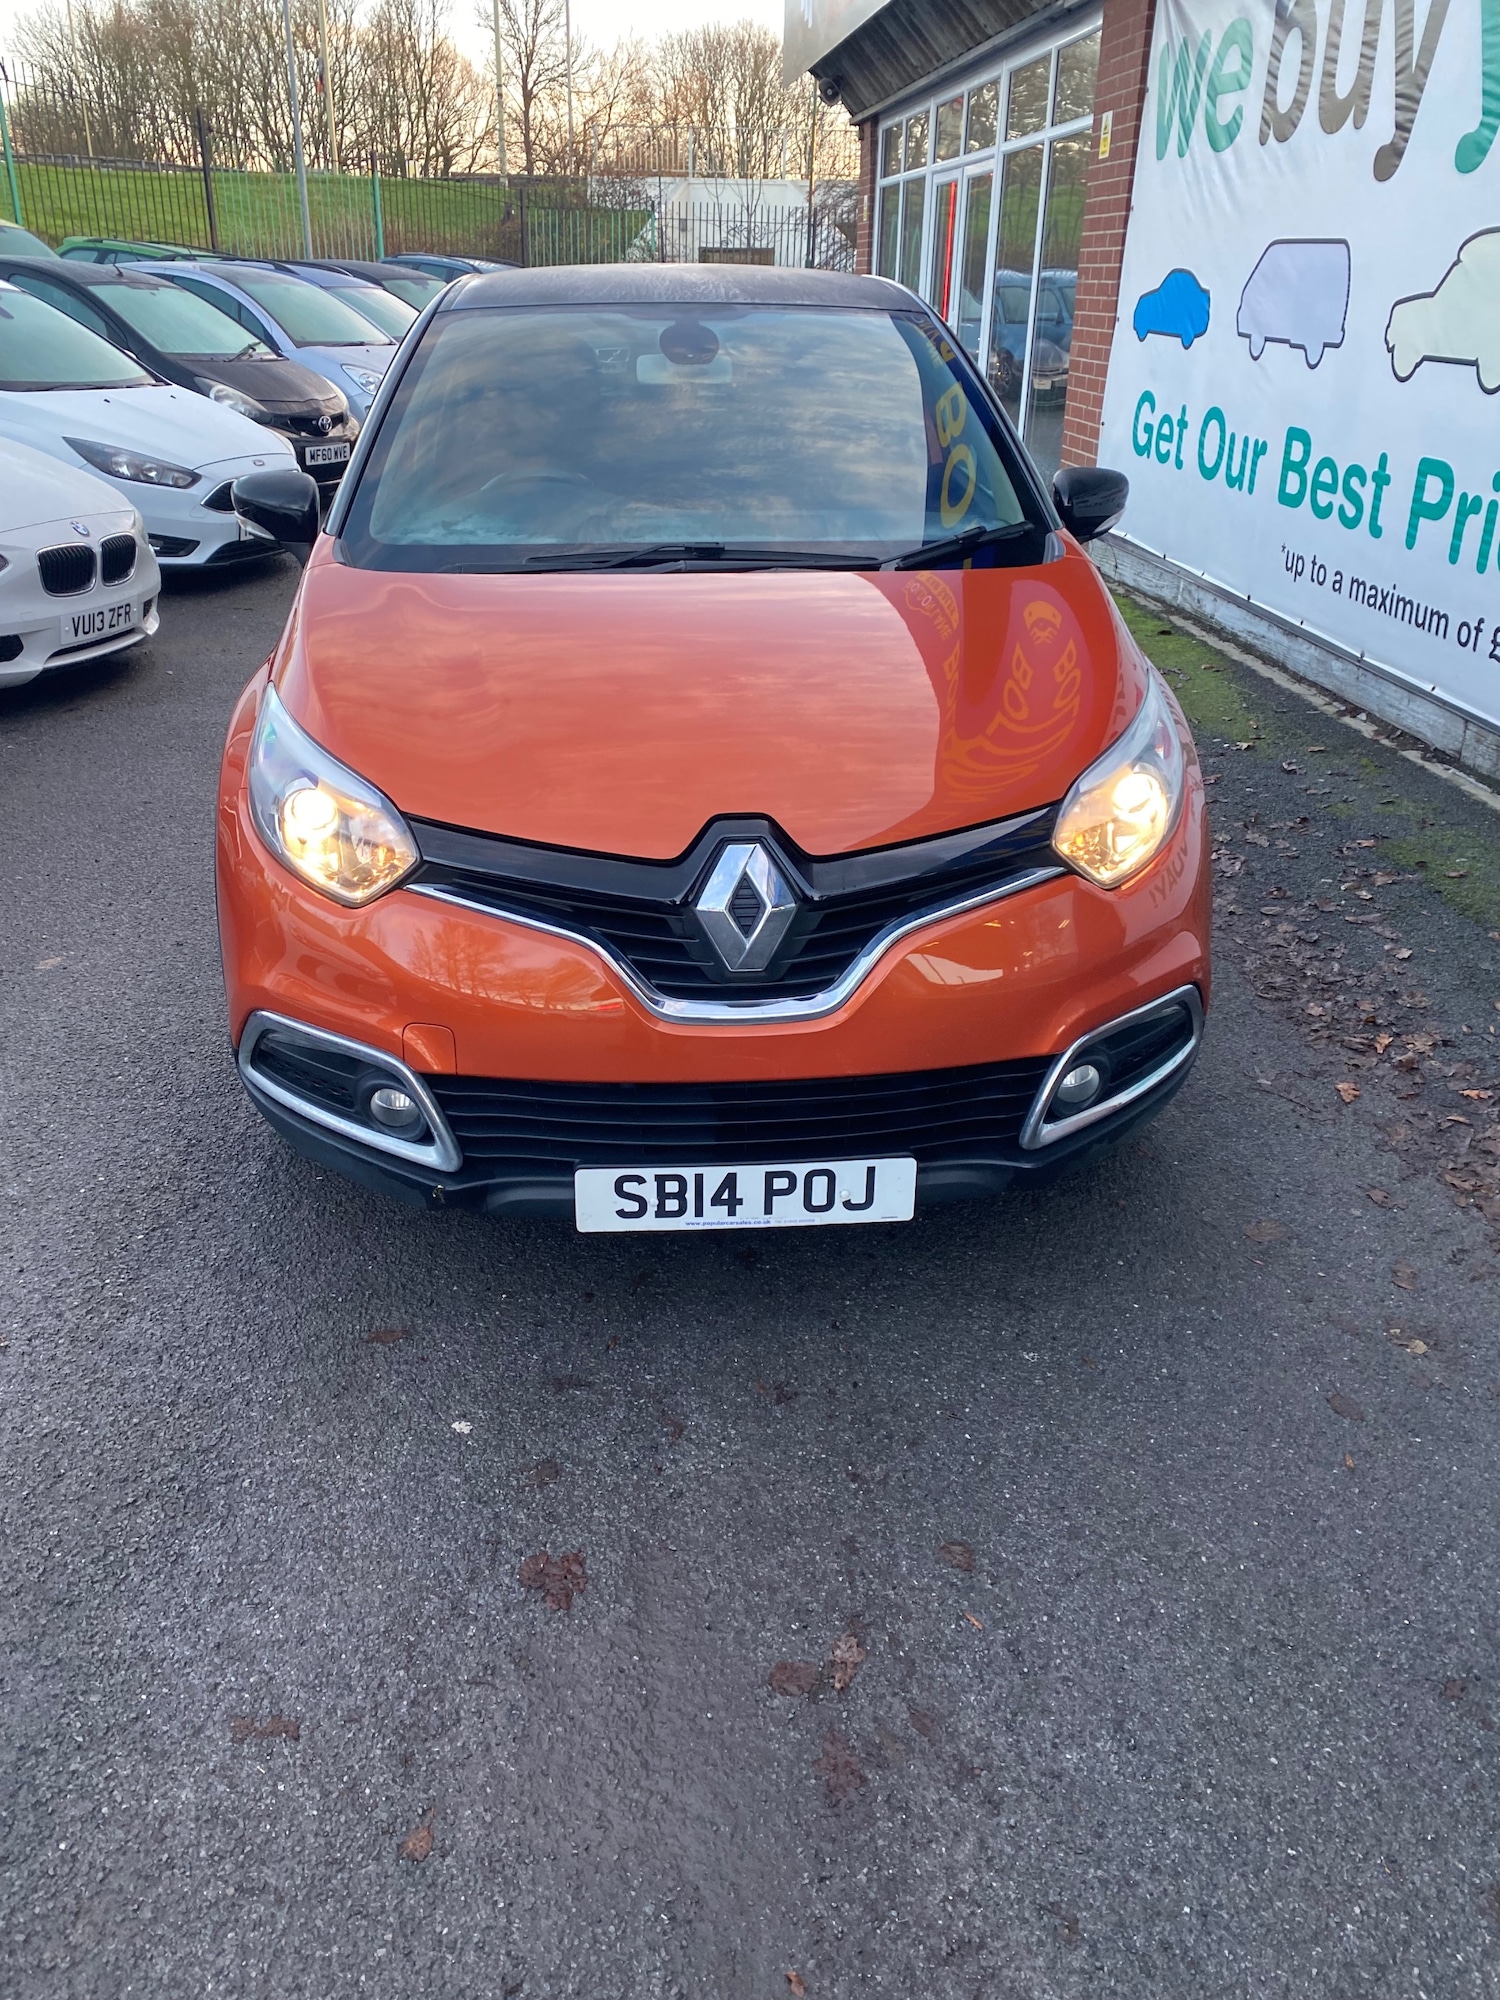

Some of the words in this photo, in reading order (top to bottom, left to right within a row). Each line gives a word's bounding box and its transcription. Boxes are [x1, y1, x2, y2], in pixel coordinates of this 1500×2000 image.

[310, 448, 332, 463] MF60
[334, 445, 347, 460] WVE
[1133, 390, 1188, 470] Get
[1198, 406, 1268, 495] Our
[1278, 426, 1391, 539] Best
[1406, 457, 1500, 574] Pri
[72, 610, 105, 637] VU13
[108, 603, 131, 629] ZFR
[1311, 555, 1327, 586] to
[1332, 570, 1343, 594] a
[1349, 576, 1449, 639] maximum
[1457, 617, 1485, 652] of
[613, 1171, 744, 1220] SB14
[763, 1166, 876, 1216] POJ
[685, 1219, 771, 1227] www.popularcarsales.co.uk
